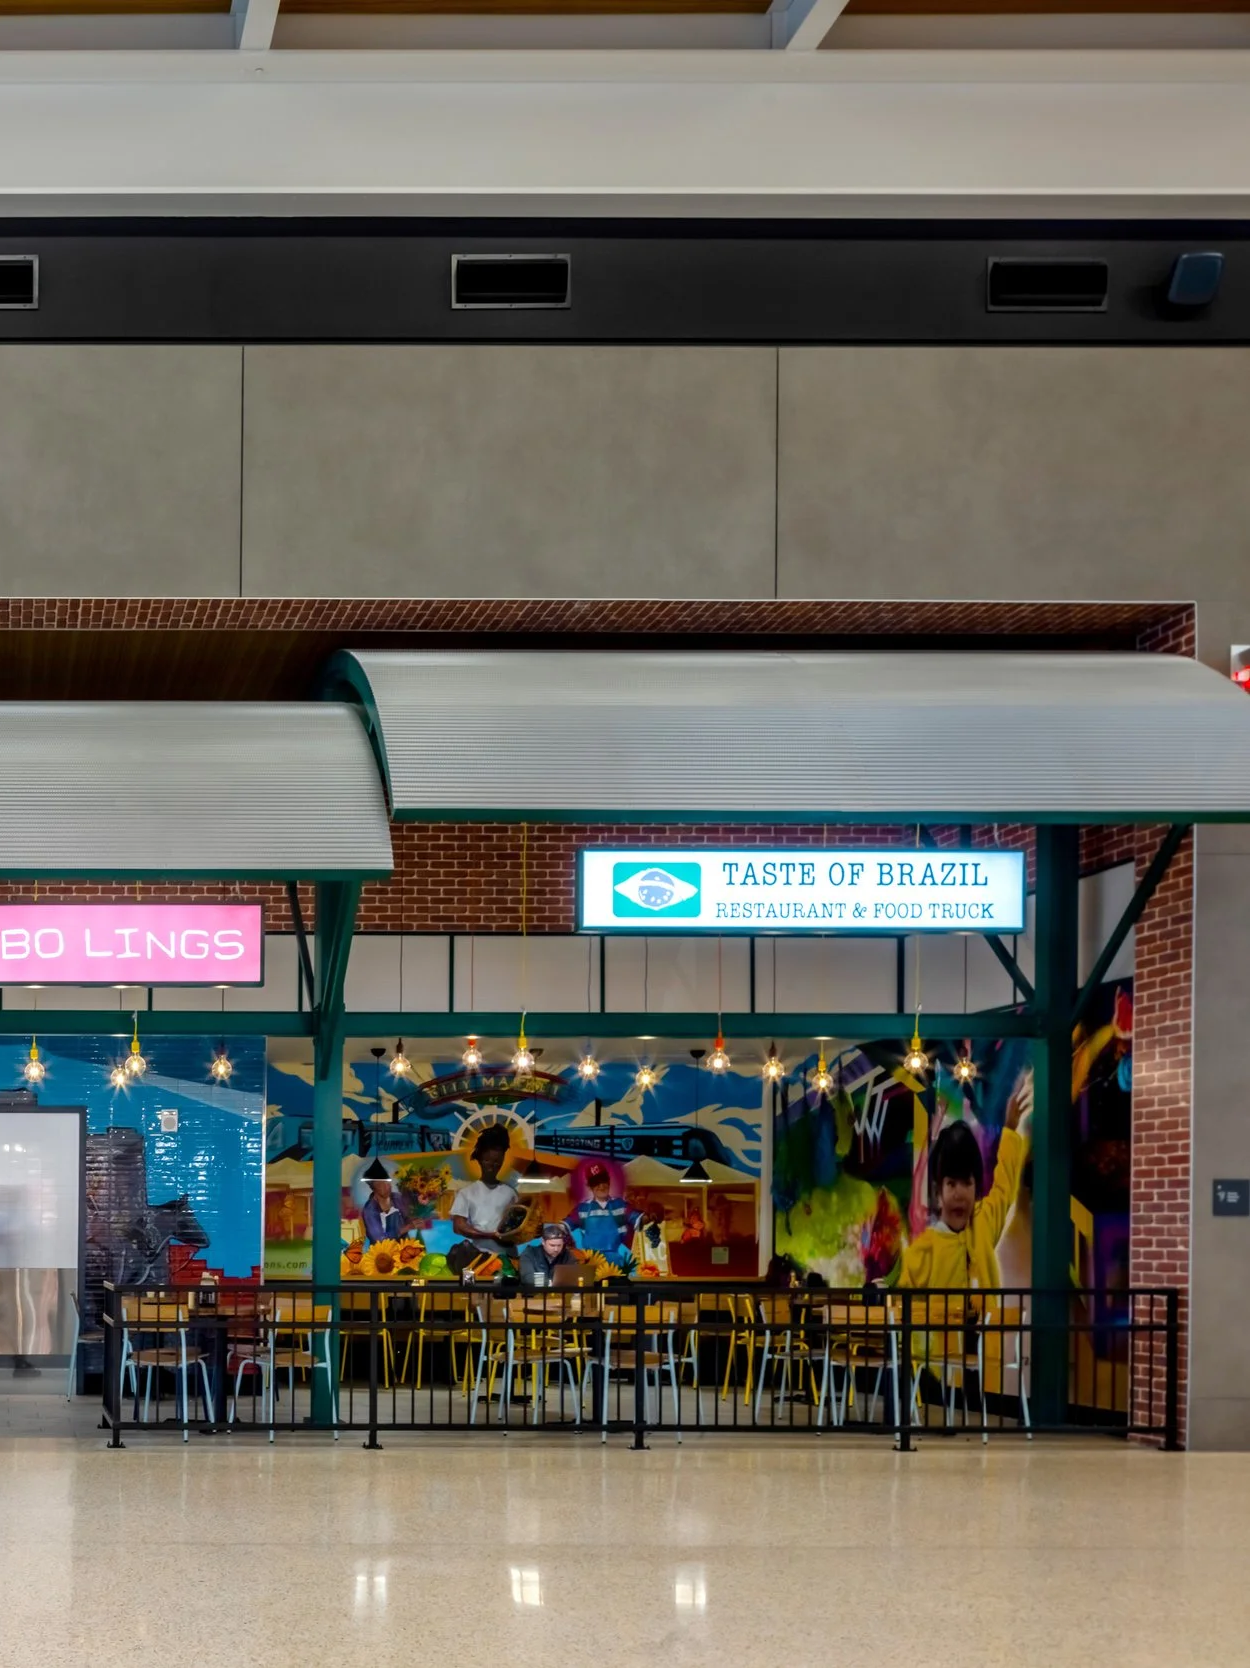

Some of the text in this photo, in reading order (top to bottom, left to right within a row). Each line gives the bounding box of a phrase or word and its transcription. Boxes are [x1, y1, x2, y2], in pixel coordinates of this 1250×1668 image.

[722, 862, 990, 887] TASTE OF BRAZIL
[715, 902, 995, 919] RESTAURANT & FOOD TRUCK
[1, 927, 245, 961] BO LINGS
